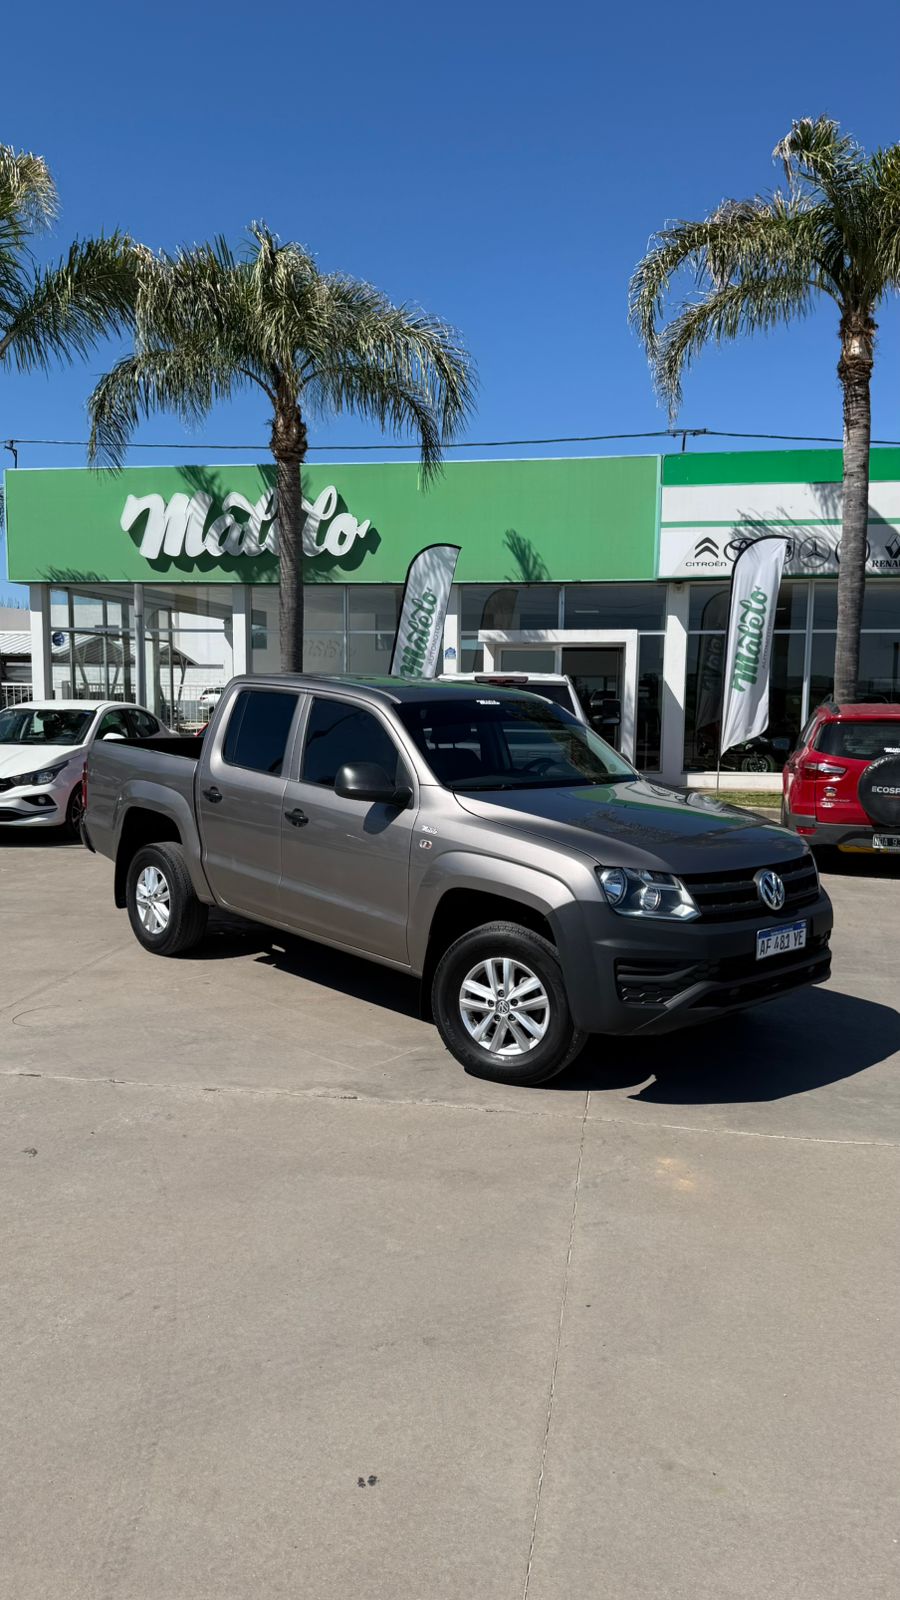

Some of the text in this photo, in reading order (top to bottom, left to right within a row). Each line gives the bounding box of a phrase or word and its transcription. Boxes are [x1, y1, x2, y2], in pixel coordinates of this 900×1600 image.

[120, 485, 371, 559] Matto
[759, 938, 772, 956] AF
[774, 933, 790, 950] 481
[793, 930, 804, 947] YE
